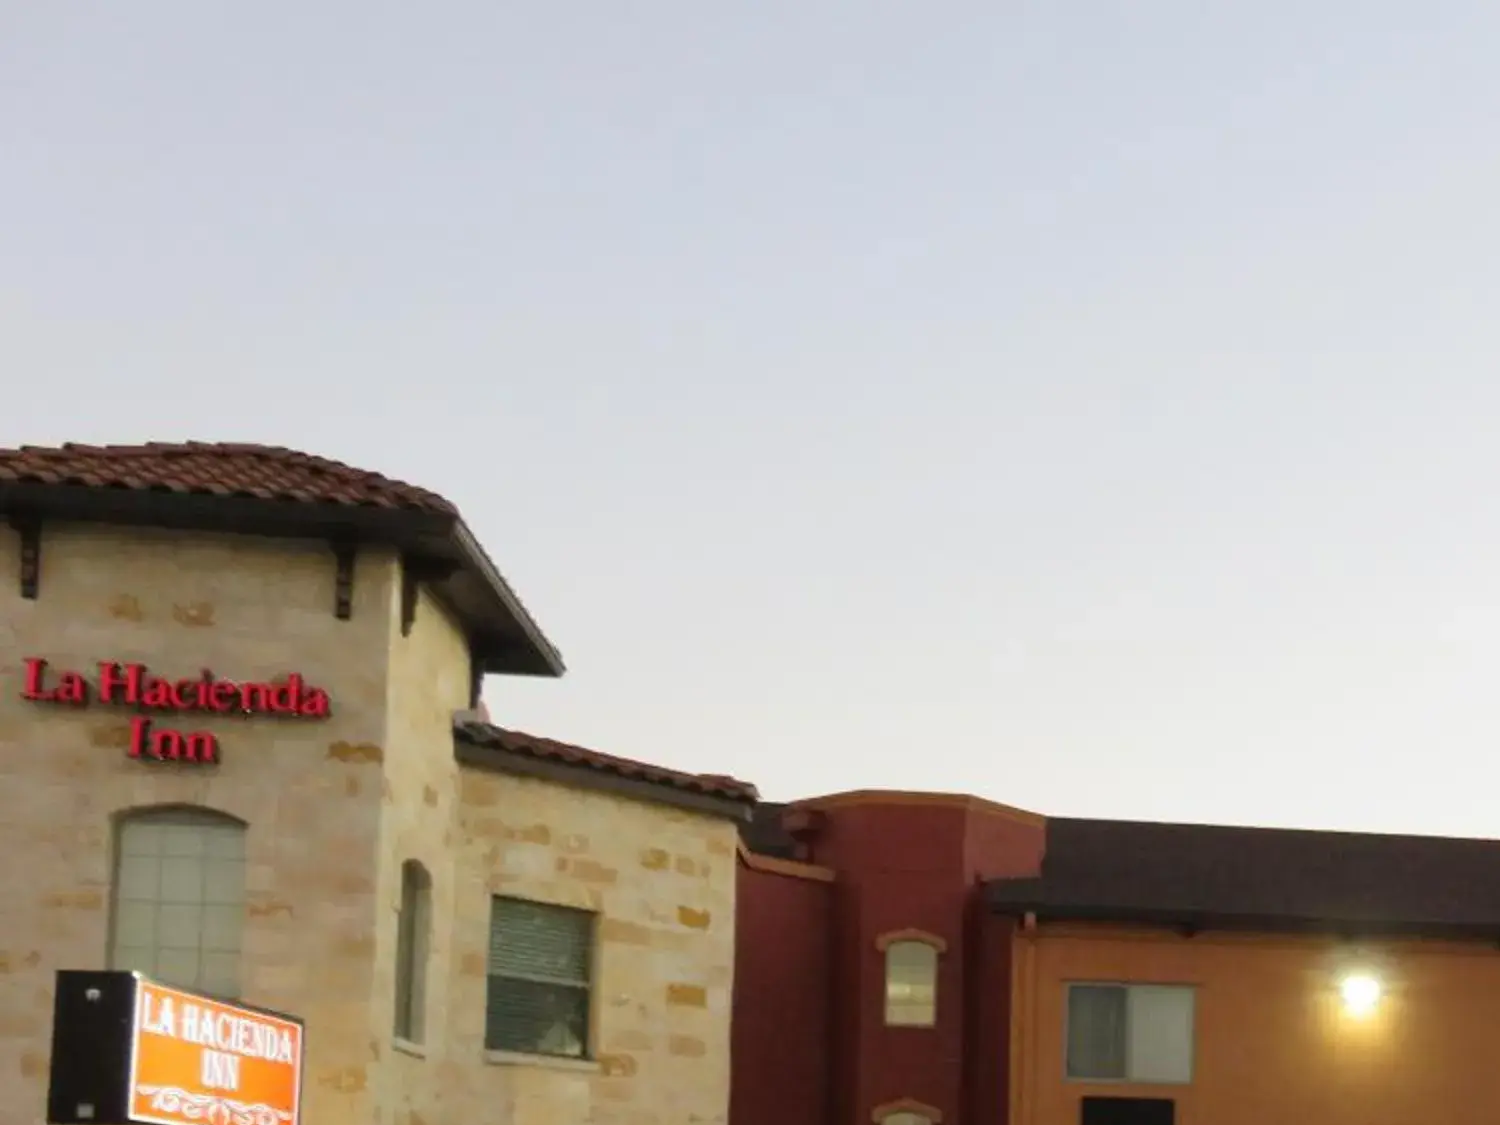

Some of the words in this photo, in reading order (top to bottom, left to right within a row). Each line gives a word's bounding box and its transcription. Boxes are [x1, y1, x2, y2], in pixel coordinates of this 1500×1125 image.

[22, 657, 87, 702] La
[99, 660, 331, 717] Hacienda
[127, 716, 219, 763] Inn
[142, 991, 176, 1037] LA
[182, 1004, 293, 1064] HACIENDA
[202, 1049, 240, 1090] INN
